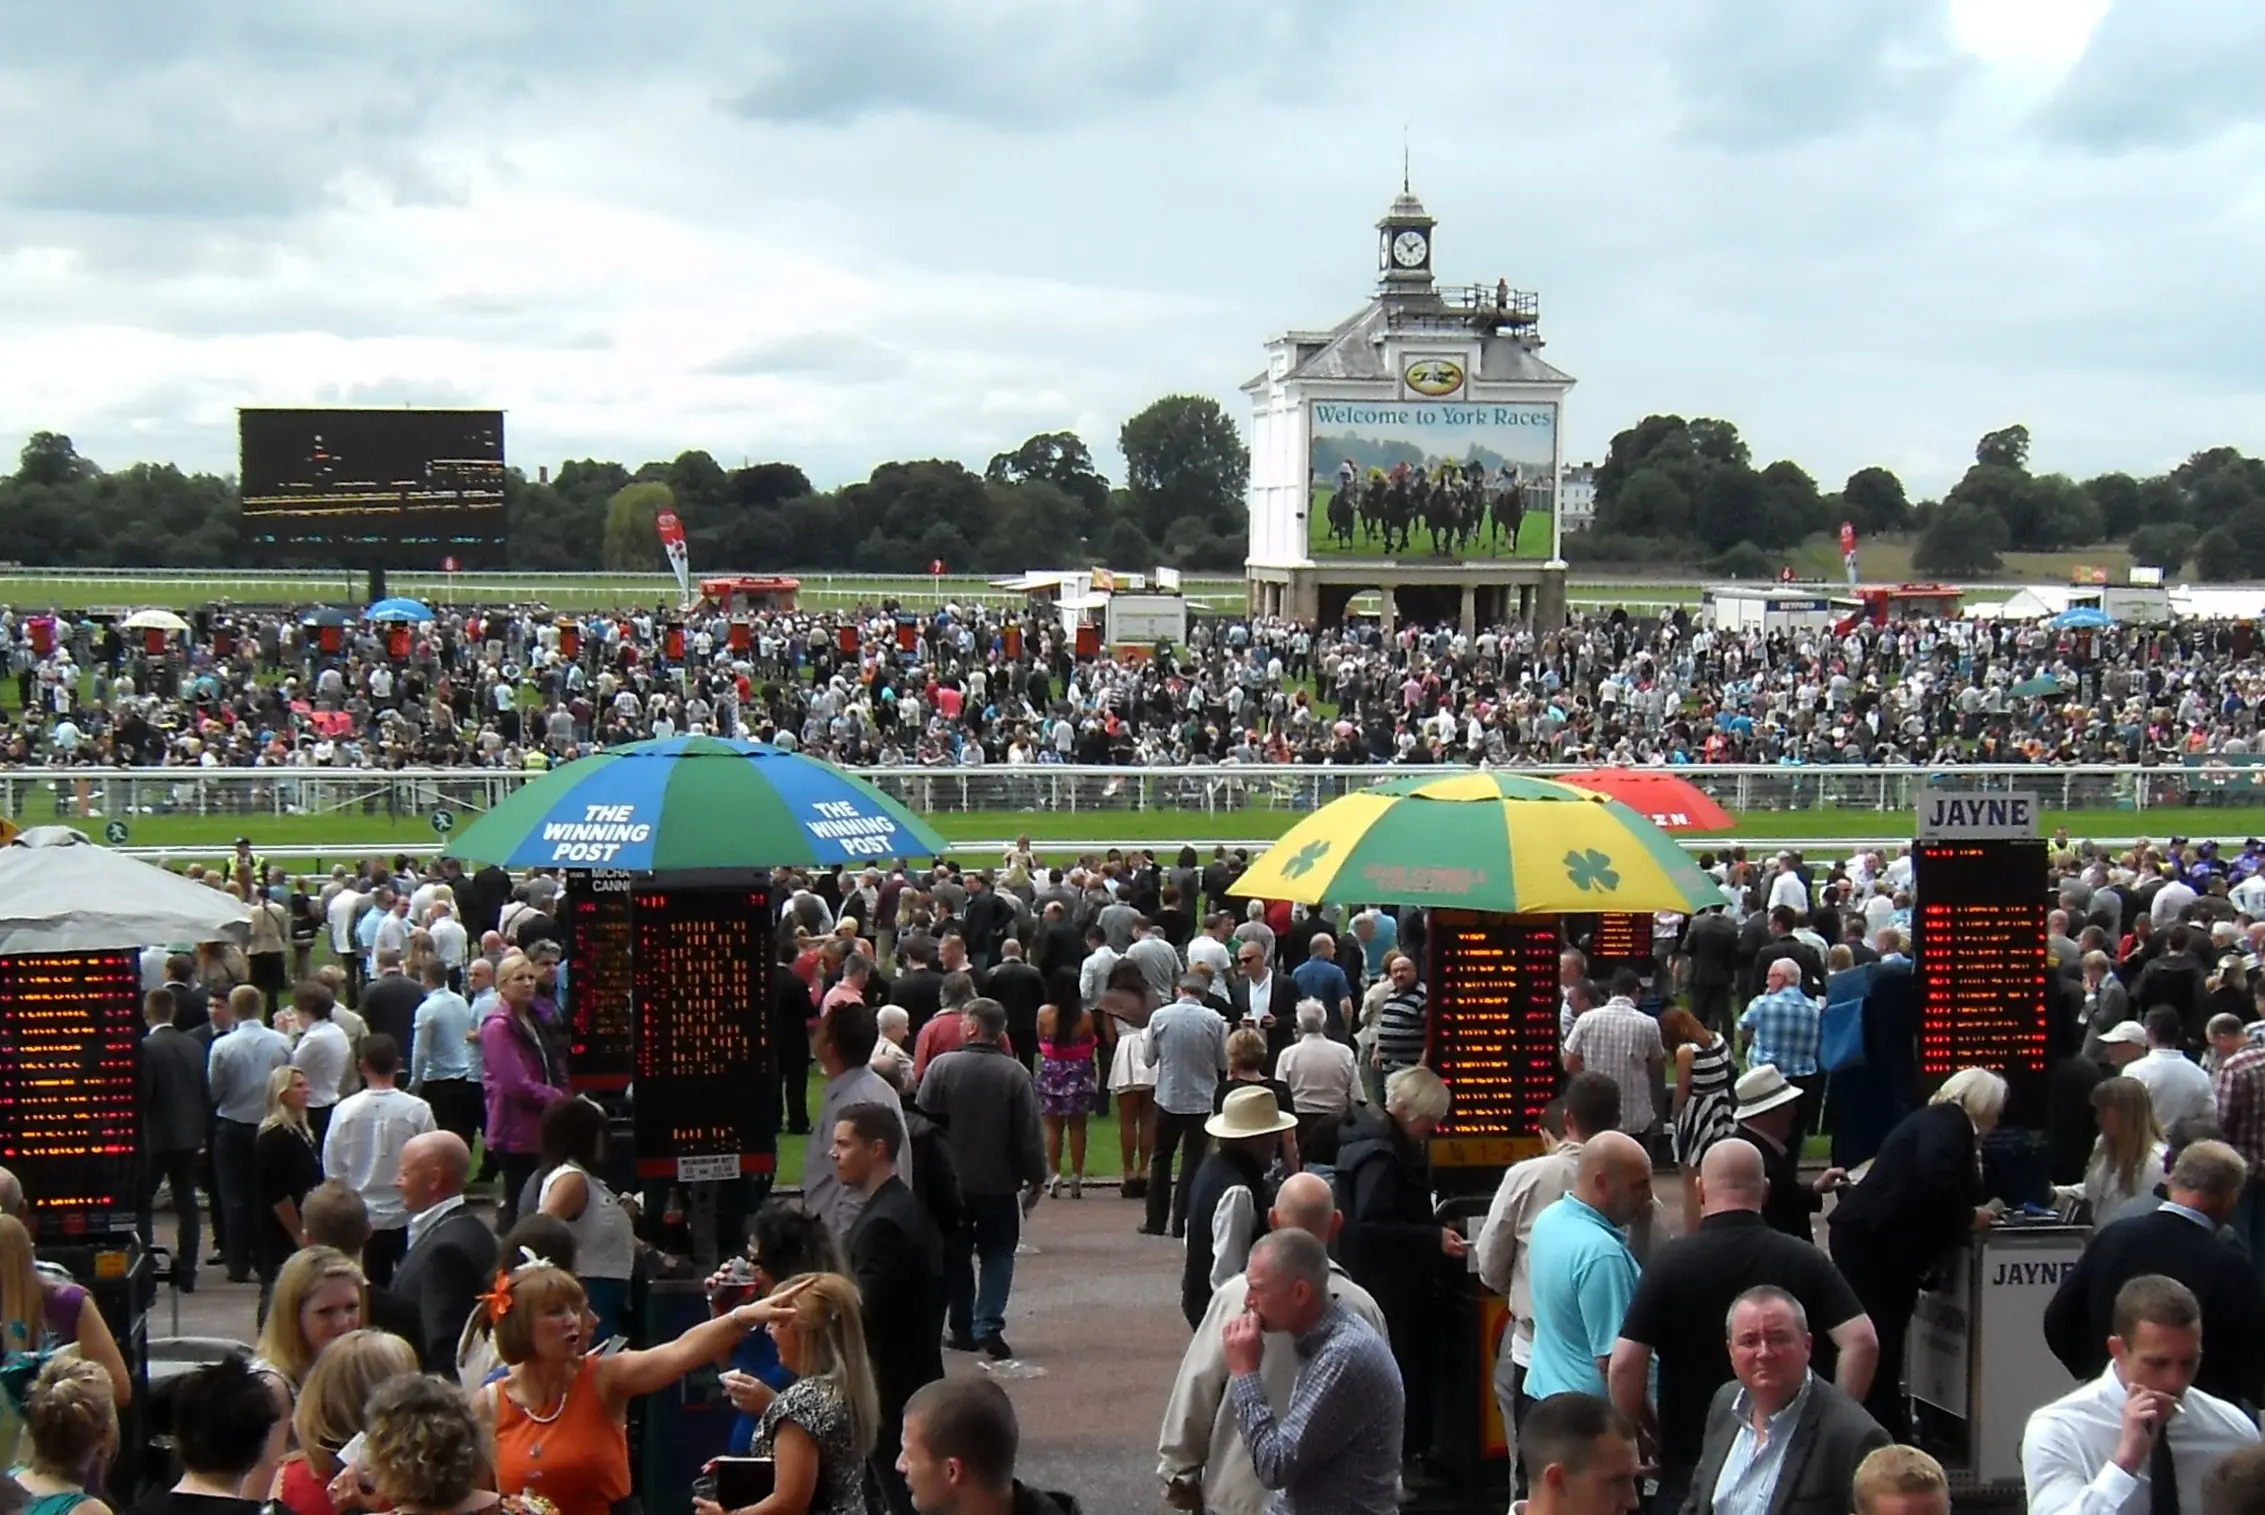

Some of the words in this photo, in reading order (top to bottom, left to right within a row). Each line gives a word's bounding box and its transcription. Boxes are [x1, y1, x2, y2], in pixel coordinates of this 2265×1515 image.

[1316, 405, 1409, 424] Welcome
[1416, 407, 1436, 425] to
[1443, 407, 1487, 425] York
[1493, 408, 1551, 425] Races
[1782, 566, 1790, 579] 6
[584, 804, 634, 822] THE
[812, 801, 860, 819] THE
[1929, 799, 2030, 826] JAYNE
[543, 822, 650, 843] WINNING
[806, 815, 896, 839] WINNING
[552, 842, 621, 862] POST
[839, 835, 894, 856] POST
[592, 868, 631, 879] MICHA
[592, 879, 631, 893] CANN
